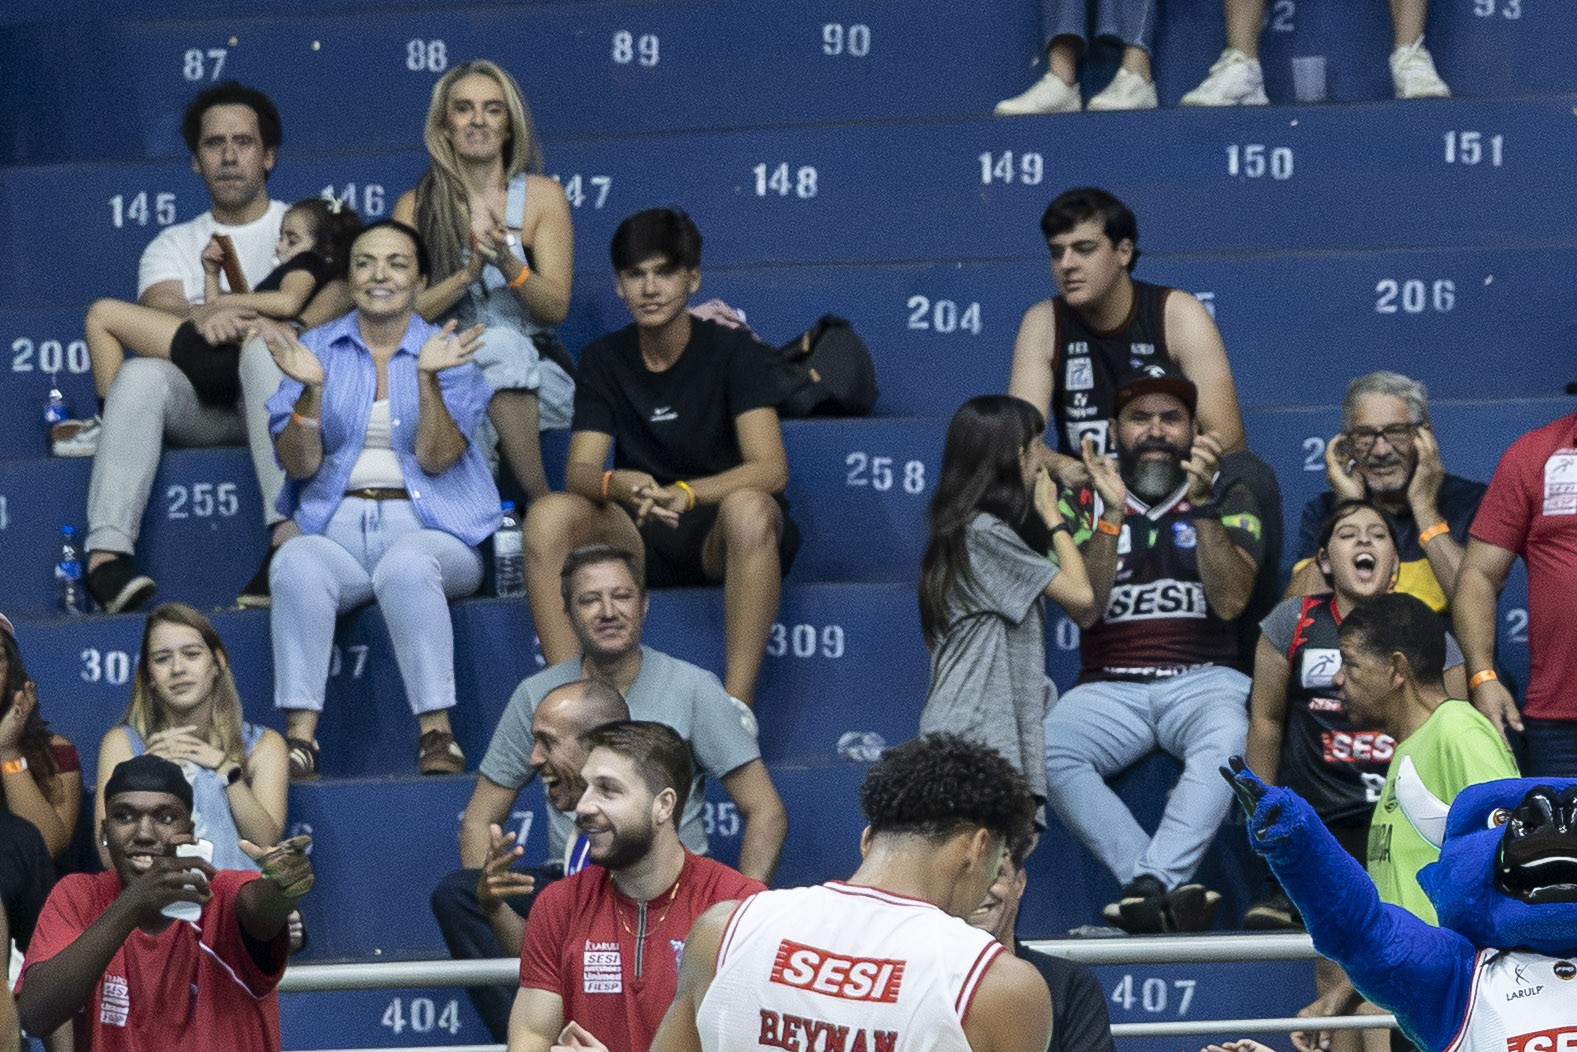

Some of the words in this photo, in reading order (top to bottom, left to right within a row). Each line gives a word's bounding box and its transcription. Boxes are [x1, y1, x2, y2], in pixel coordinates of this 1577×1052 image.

[406, 40, 448, 71] 88
[612, 31, 660, 66] 89
[822, 23, 871, 57] 90
[183, 48, 227, 80] 87
[1226, 144, 1293, 180] 150
[1444, 131, 1503, 166] 151
[753, 163, 818, 199] 148
[979, 151, 1044, 185] 149
[109, 194, 176, 227] 145
[1376, 279, 1456, 314] 206
[906, 296, 983, 335] 204
[11, 339, 91, 374] 200
[845, 452, 925, 495] 258
[167, 483, 239, 519] 255
[1109, 585, 1195, 617] SESI
[767, 622, 845, 659] 309
[1331, 733, 1396, 760] SES
[587, 953, 618, 964] SESI
[783, 949, 894, 1000] SESI
[1113, 974, 1198, 1015] 407
[381, 998, 463, 1034] 404
